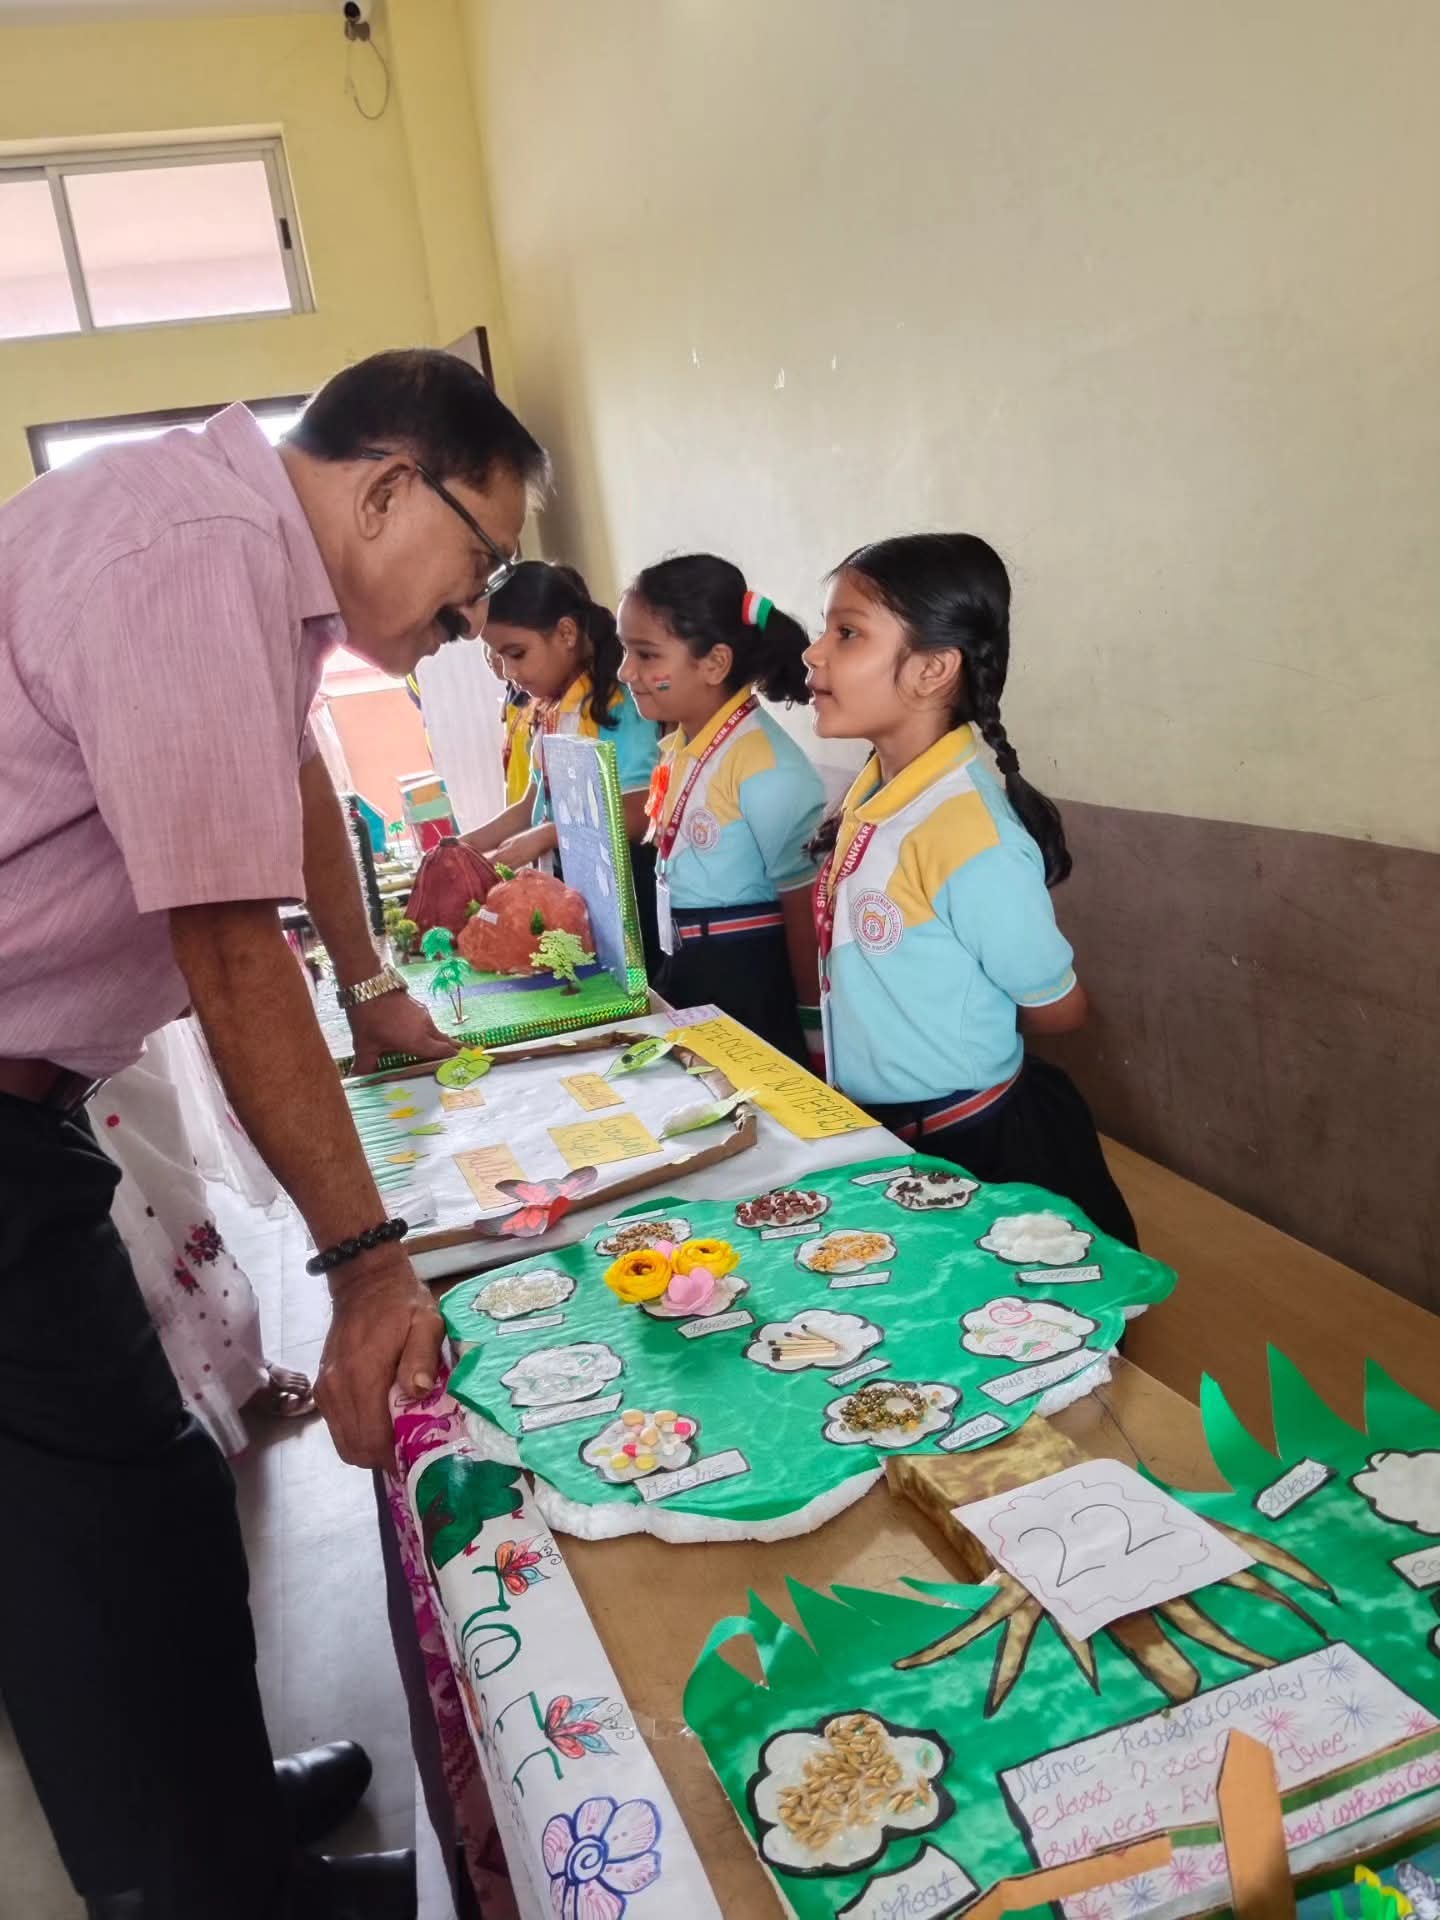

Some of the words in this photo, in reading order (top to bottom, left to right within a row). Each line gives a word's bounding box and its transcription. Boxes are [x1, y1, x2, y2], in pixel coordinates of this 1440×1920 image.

[1017, 1503, 1176, 1588] 22
[1016, 1756, 1096, 1805] Name
[1215, 1673, 1308, 1719] Pandey
[1181, 1783, 1216, 1815] EV
